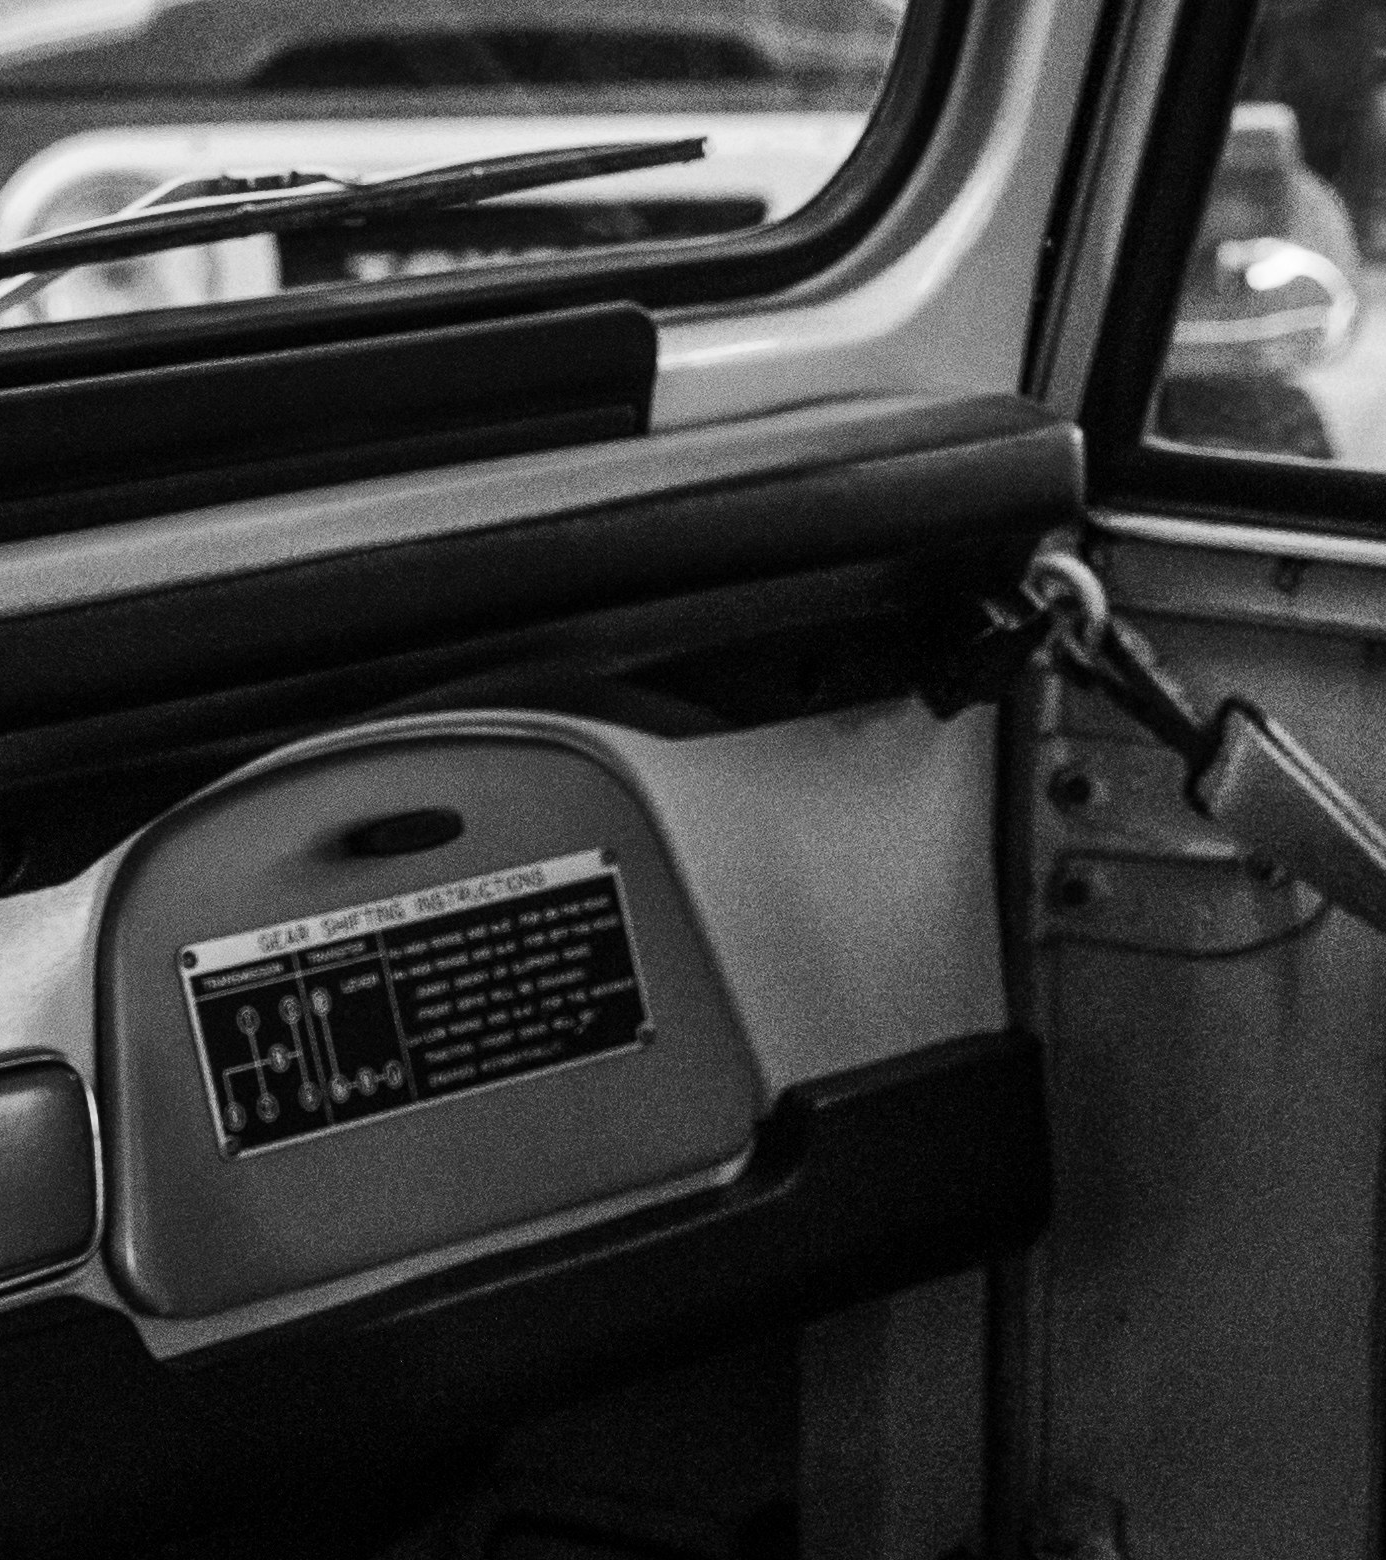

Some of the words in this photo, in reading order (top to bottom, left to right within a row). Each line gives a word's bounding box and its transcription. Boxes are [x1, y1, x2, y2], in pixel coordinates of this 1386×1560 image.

[257, 924, 310, 952] GEAR
[320, 901, 406, 937] SHIFTING
[417, 868, 546, 913] INSTRUCTIONS
